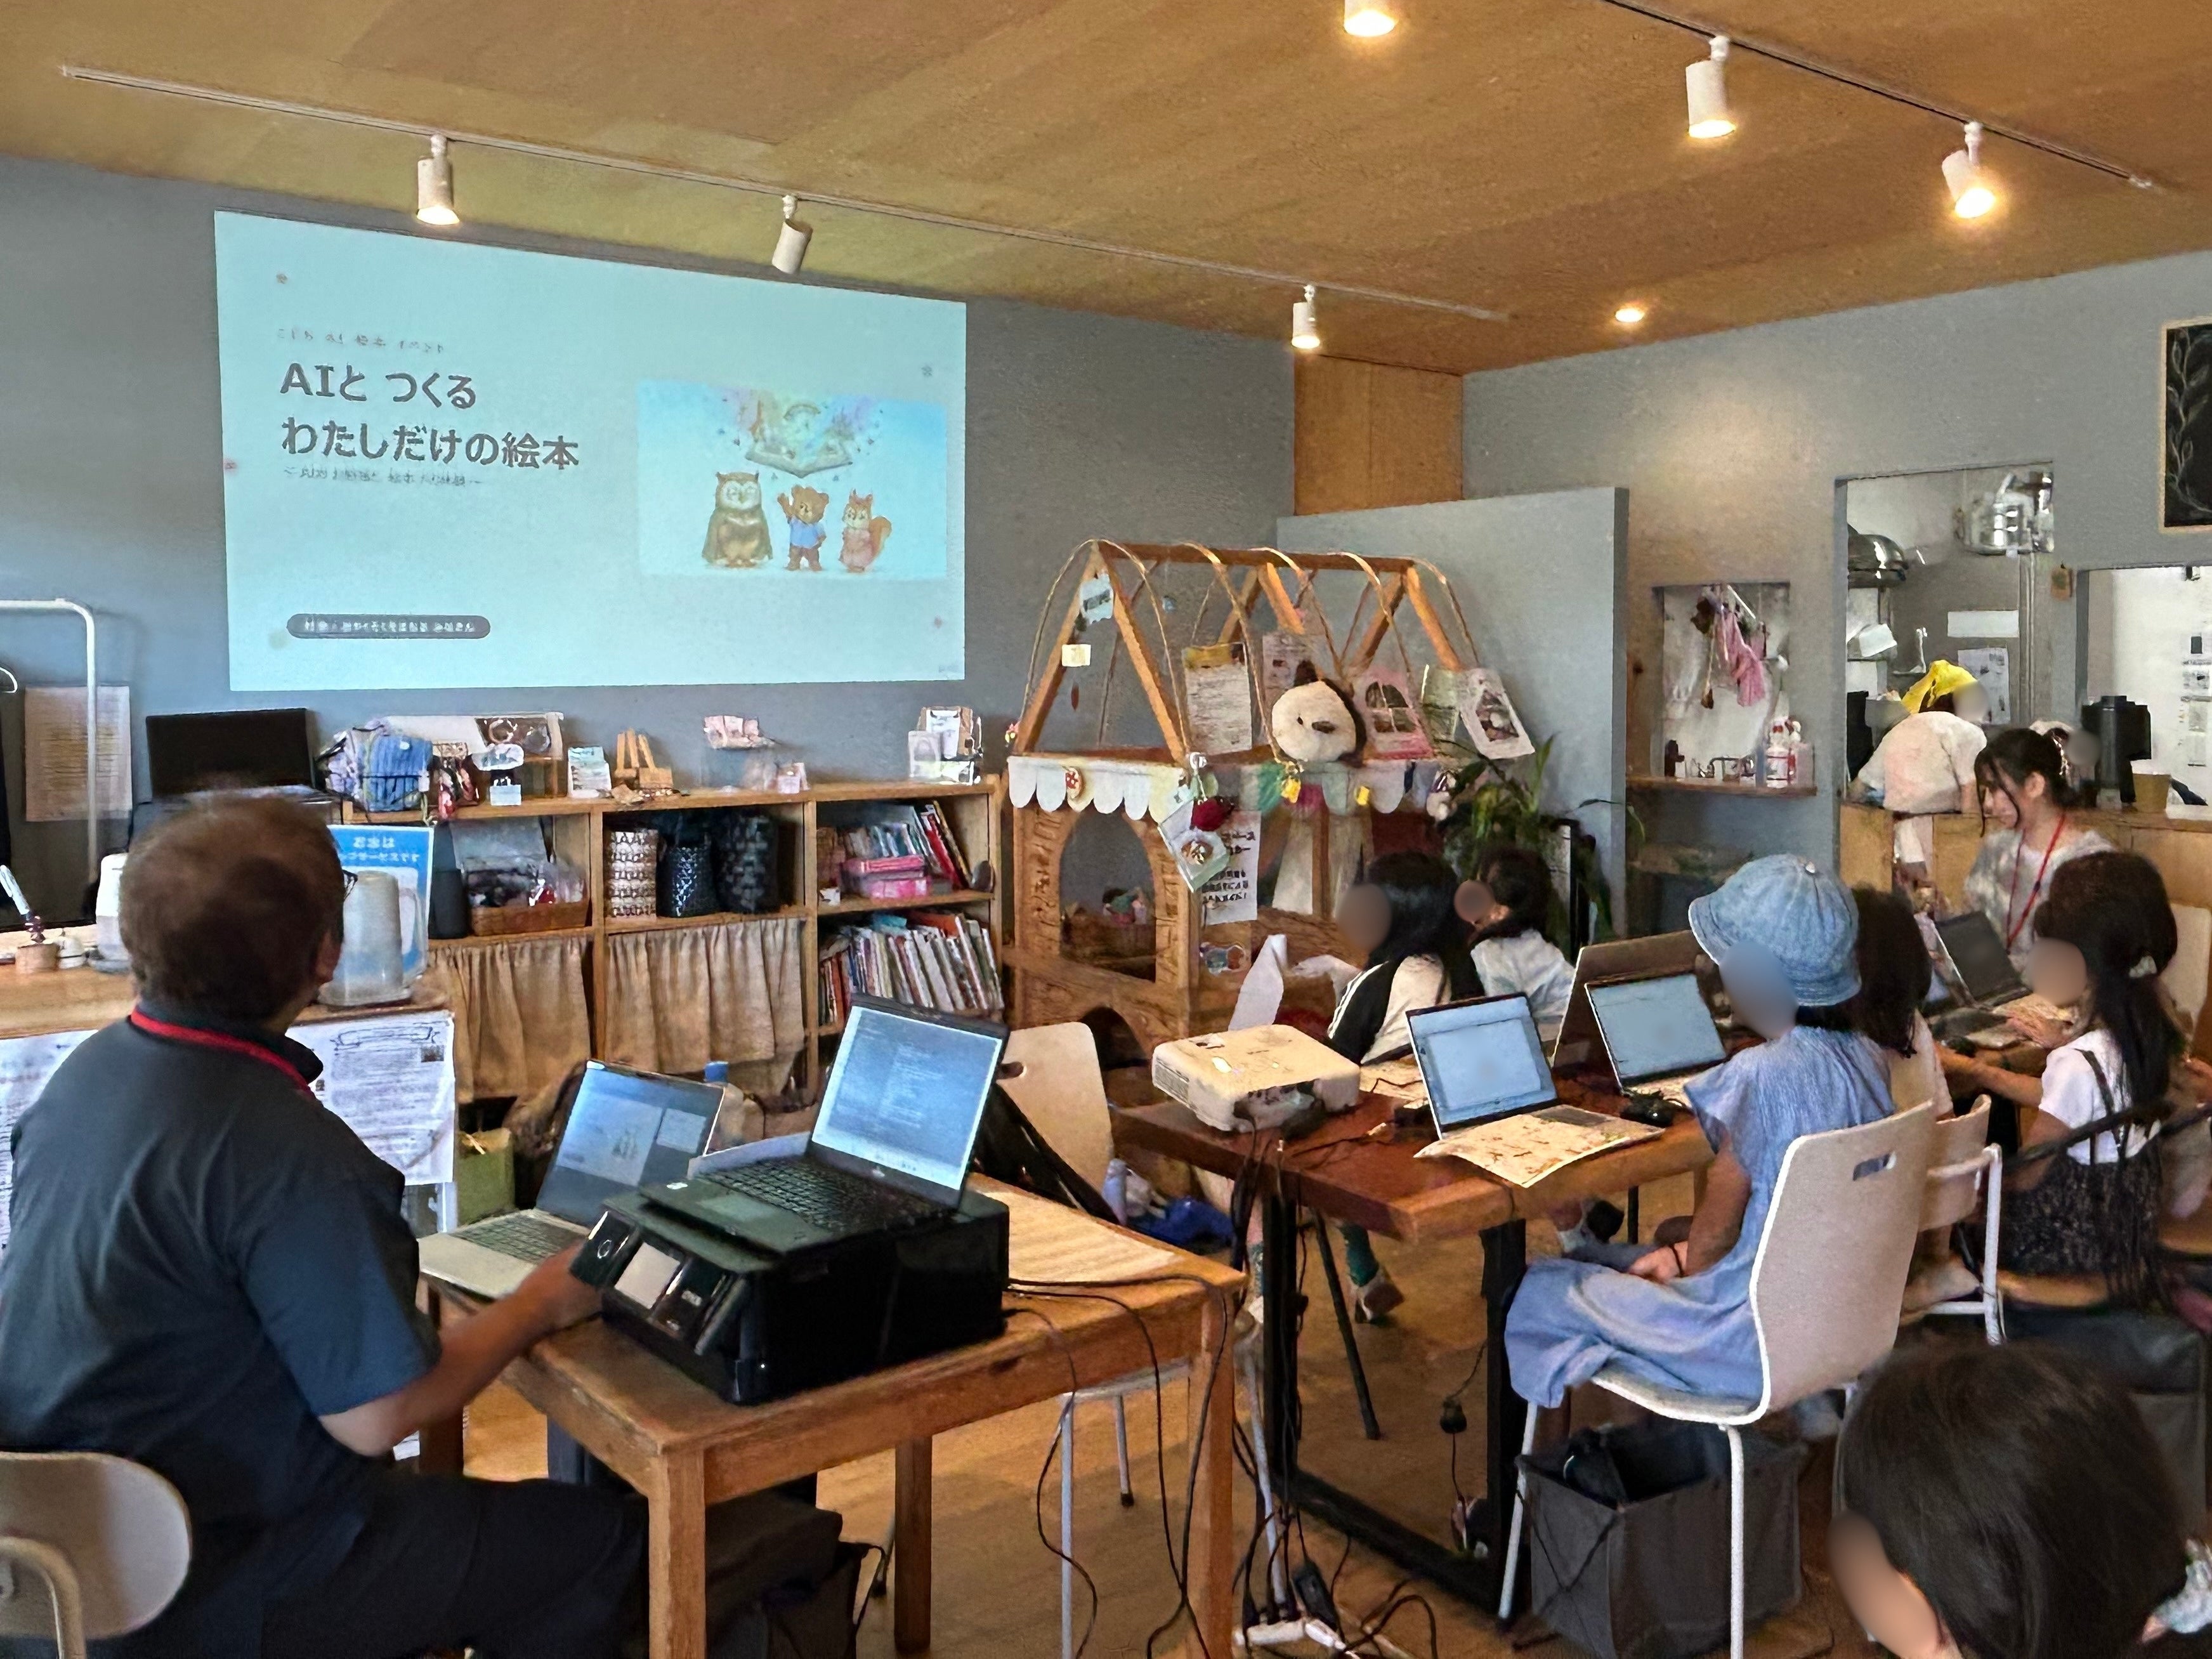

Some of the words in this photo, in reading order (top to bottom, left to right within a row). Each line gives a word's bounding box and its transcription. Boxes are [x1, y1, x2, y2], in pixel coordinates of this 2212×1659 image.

[280, 362, 367, 402] AIと
[385, 372, 476, 409] つくる
[282, 416, 579, 470] わたしだけの絵本
